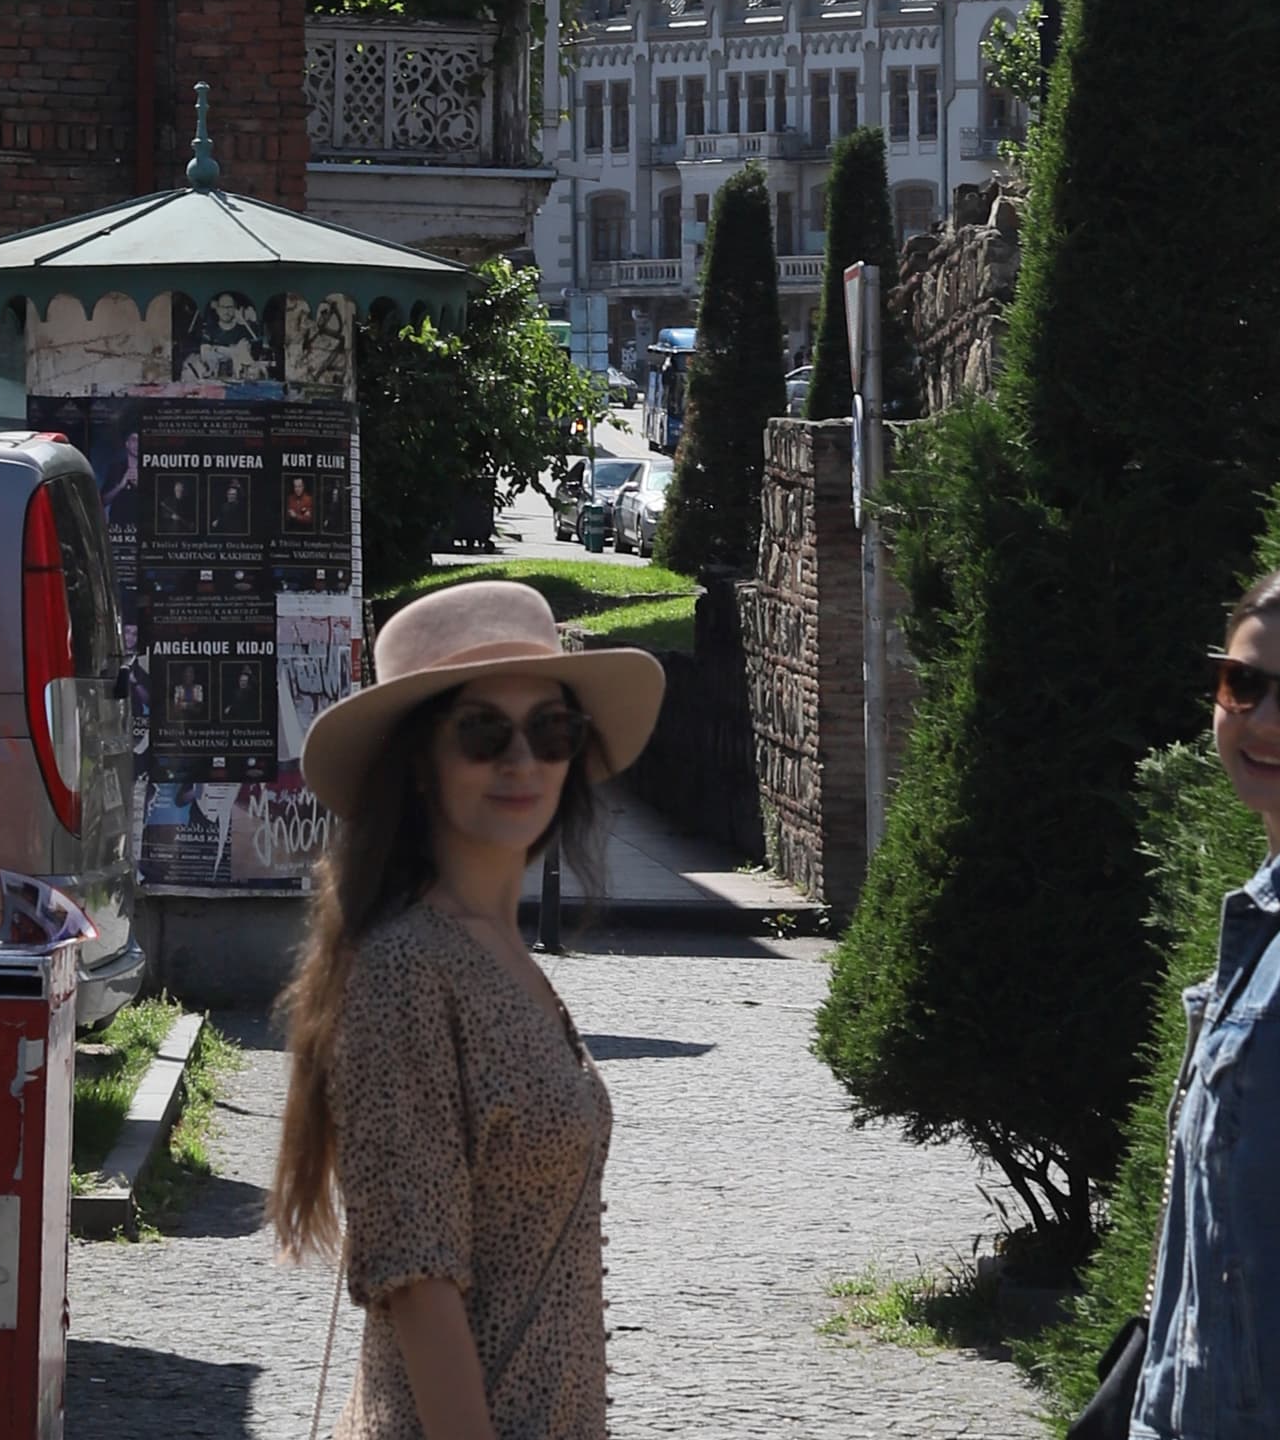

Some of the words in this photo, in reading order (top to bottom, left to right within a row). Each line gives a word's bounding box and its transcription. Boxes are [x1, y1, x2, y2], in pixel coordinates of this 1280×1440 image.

[143, 454, 200, 469] PAQUITO
[203, 455, 264, 470] D'RIVERA
[282, 453, 312, 467] KURT
[182, 542, 224, 551] Symphony
[167, 551, 217, 561] VAKHTANG
[153, 637, 229, 656] ANGÉLIQUE
[237, 641, 274, 655] KIDJO
